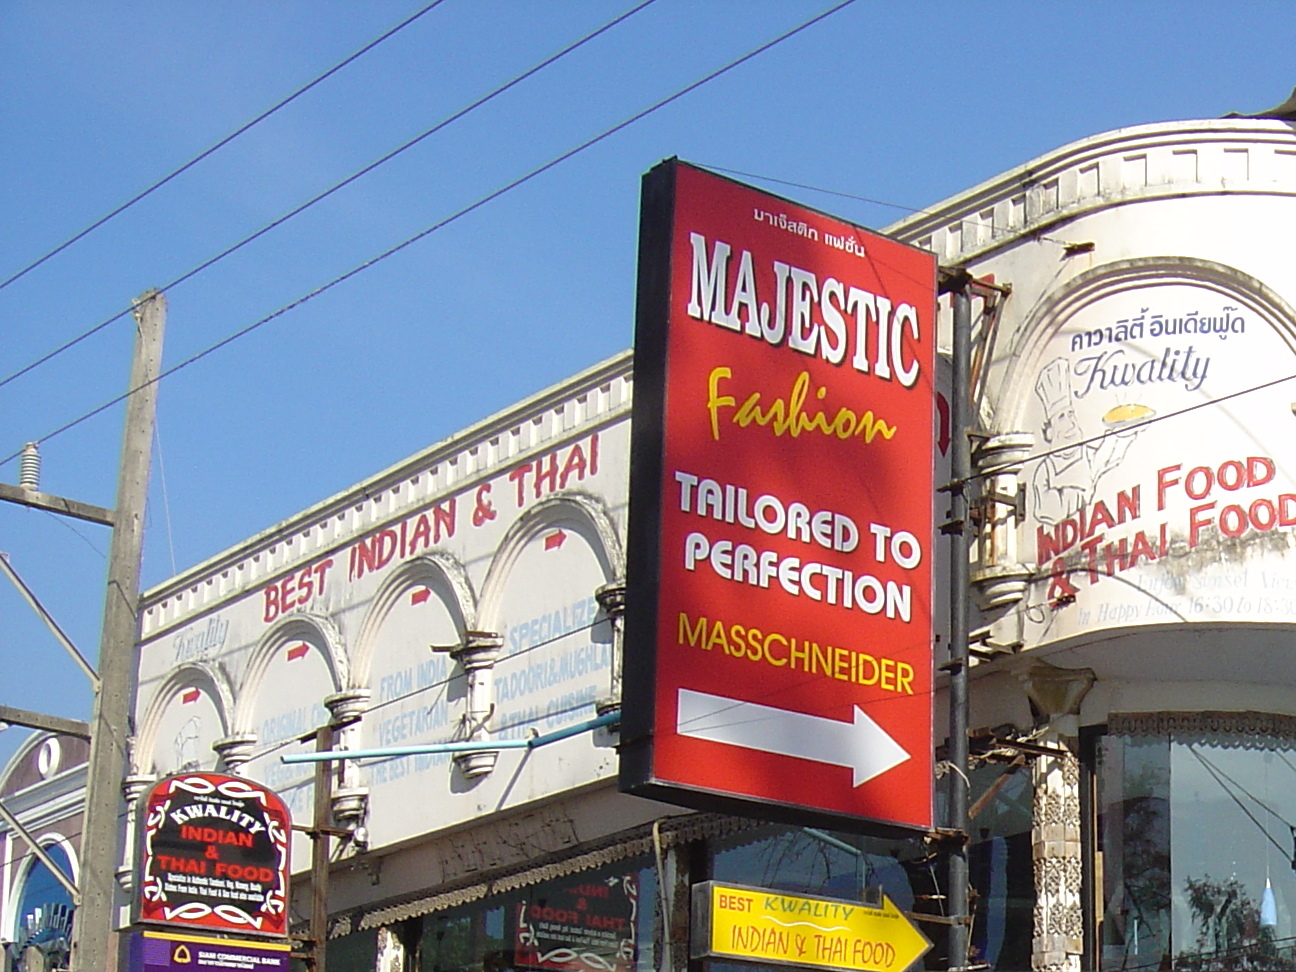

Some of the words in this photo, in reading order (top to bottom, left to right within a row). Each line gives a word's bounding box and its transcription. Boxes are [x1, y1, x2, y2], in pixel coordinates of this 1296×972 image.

[688, 231, 919, 388] MAJESTIC
[1074, 346, 1211, 399] Kwality
[707, 366, 897, 443] Fashion
[264, 560, 333, 623] BEST
[348, 498, 457, 583] INDIAN
[472, 484, 497, 527] &
[509, 434, 600, 507] THAI
[675, 471, 859, 553] TAILORED
[870, 522, 922, 569] TO
[1037, 484, 1141, 566] INDIAN
[1157, 457, 1275, 511] FOOD
[685, 533, 911, 622] PERFECTION
[1081, 522, 1168, 585] THAI
[1098, 601, 1141, 623] Happy
[381, 668, 412, 702] FROM
[417, 655, 447, 691] INDIA
[678, 612, 914, 695] MASSCHNEIDER
[378, 701, 448, 747] VEGETARIAN
[170, 804, 266, 835] KWALITY
[181, 825, 254, 848] INDIAN
[157, 855, 207, 875] THAI
[215, 862, 274, 882] FOOD
[205, 845, 219, 860] &
[719, 894, 754, 913] BEST
[764, 896, 855, 921] KWALITY
[732, 925, 790, 955] INDIAN
[795, 935, 807, 957] &
[814, 935, 848, 962] THAI
[853, 939, 896, 969] FOOD
